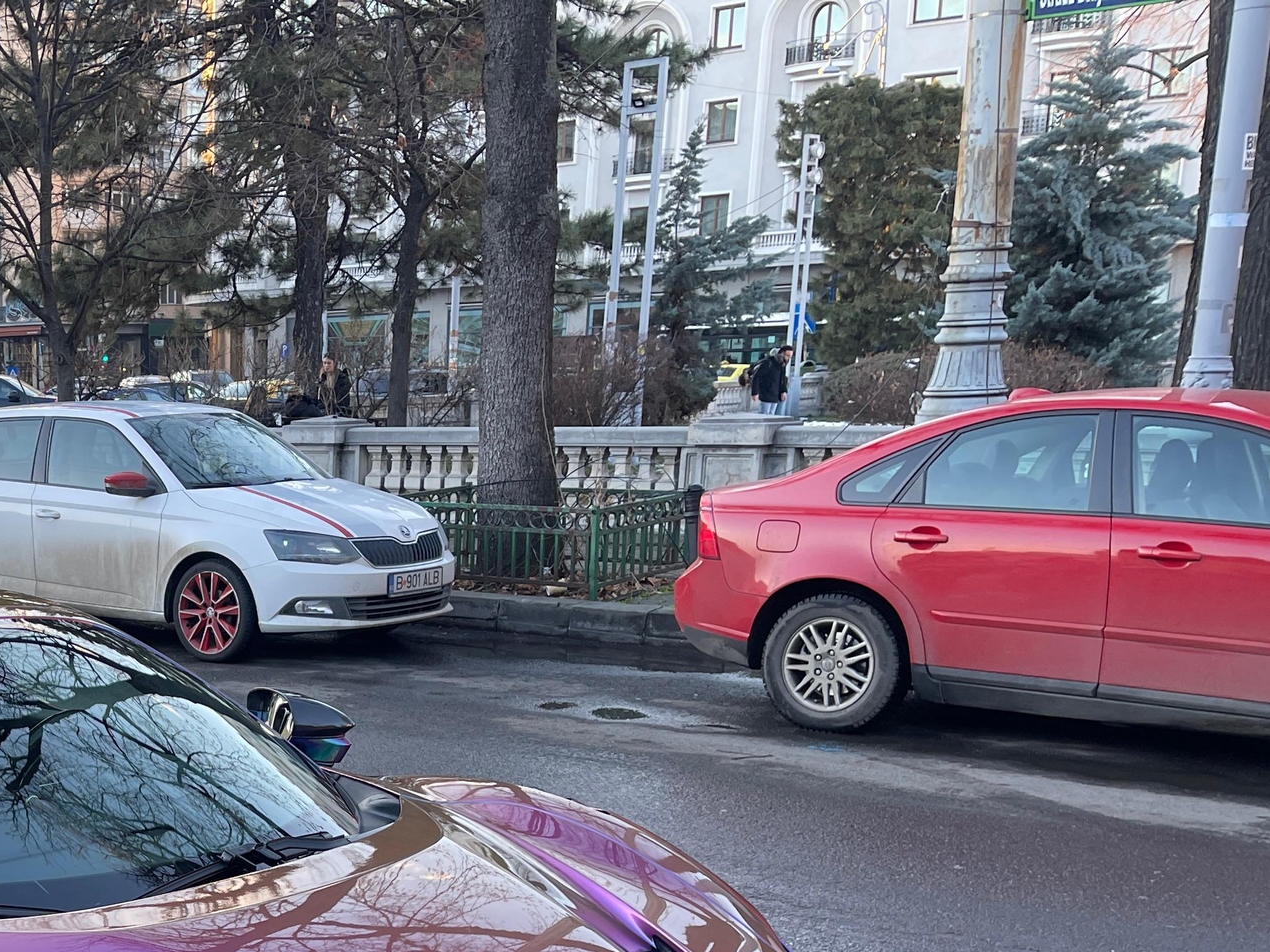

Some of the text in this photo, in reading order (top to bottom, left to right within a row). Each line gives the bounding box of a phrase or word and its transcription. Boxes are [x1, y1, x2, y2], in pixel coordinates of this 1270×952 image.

[396, 570, 440, 590] B 901 ALB
